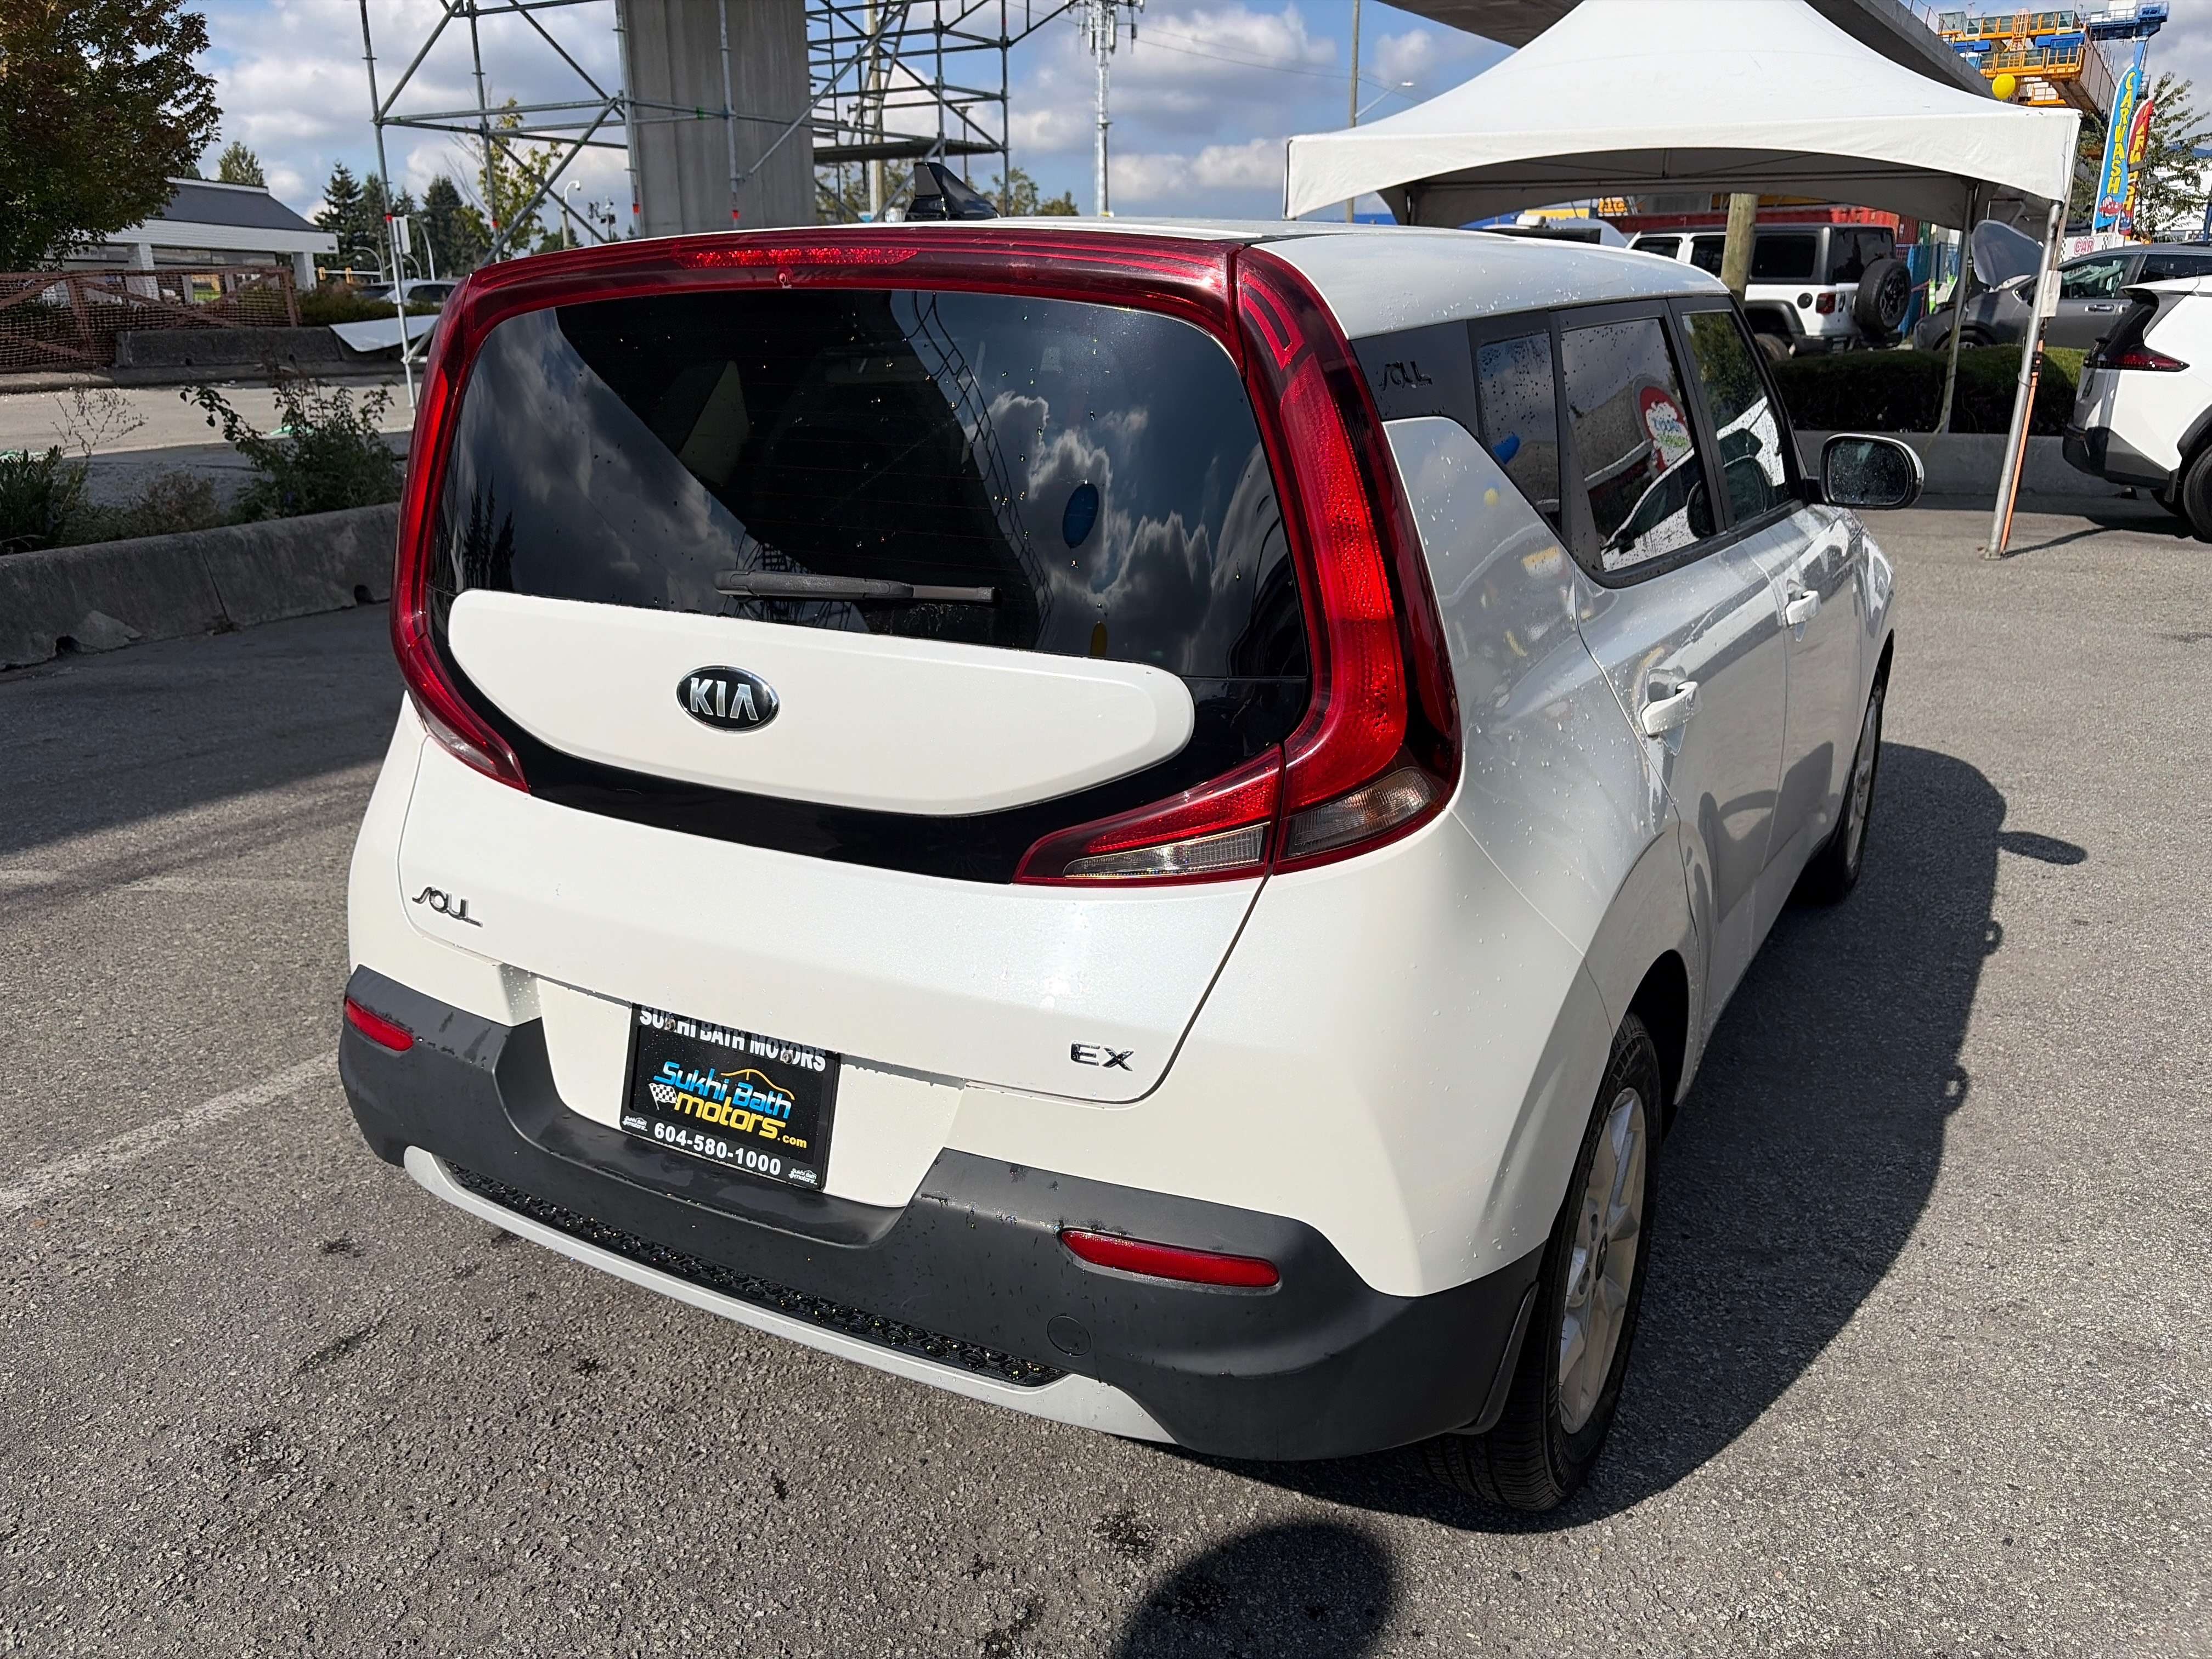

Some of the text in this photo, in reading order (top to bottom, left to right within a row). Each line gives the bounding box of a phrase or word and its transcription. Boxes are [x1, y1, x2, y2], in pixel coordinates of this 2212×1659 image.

[2074, 237, 2095, 255] CAR
[690, 677, 759, 721] KIA
[412, 887, 483, 928] SOUL
[700, 1020, 746, 1051] BATH
[749, 1034, 826, 1072] MOTORS
[1070, 1041, 1135, 1071] EX
[653, 1061, 792, 1119] Sukhi Bath
[654, 1122, 781, 1175] 604-580-1000
